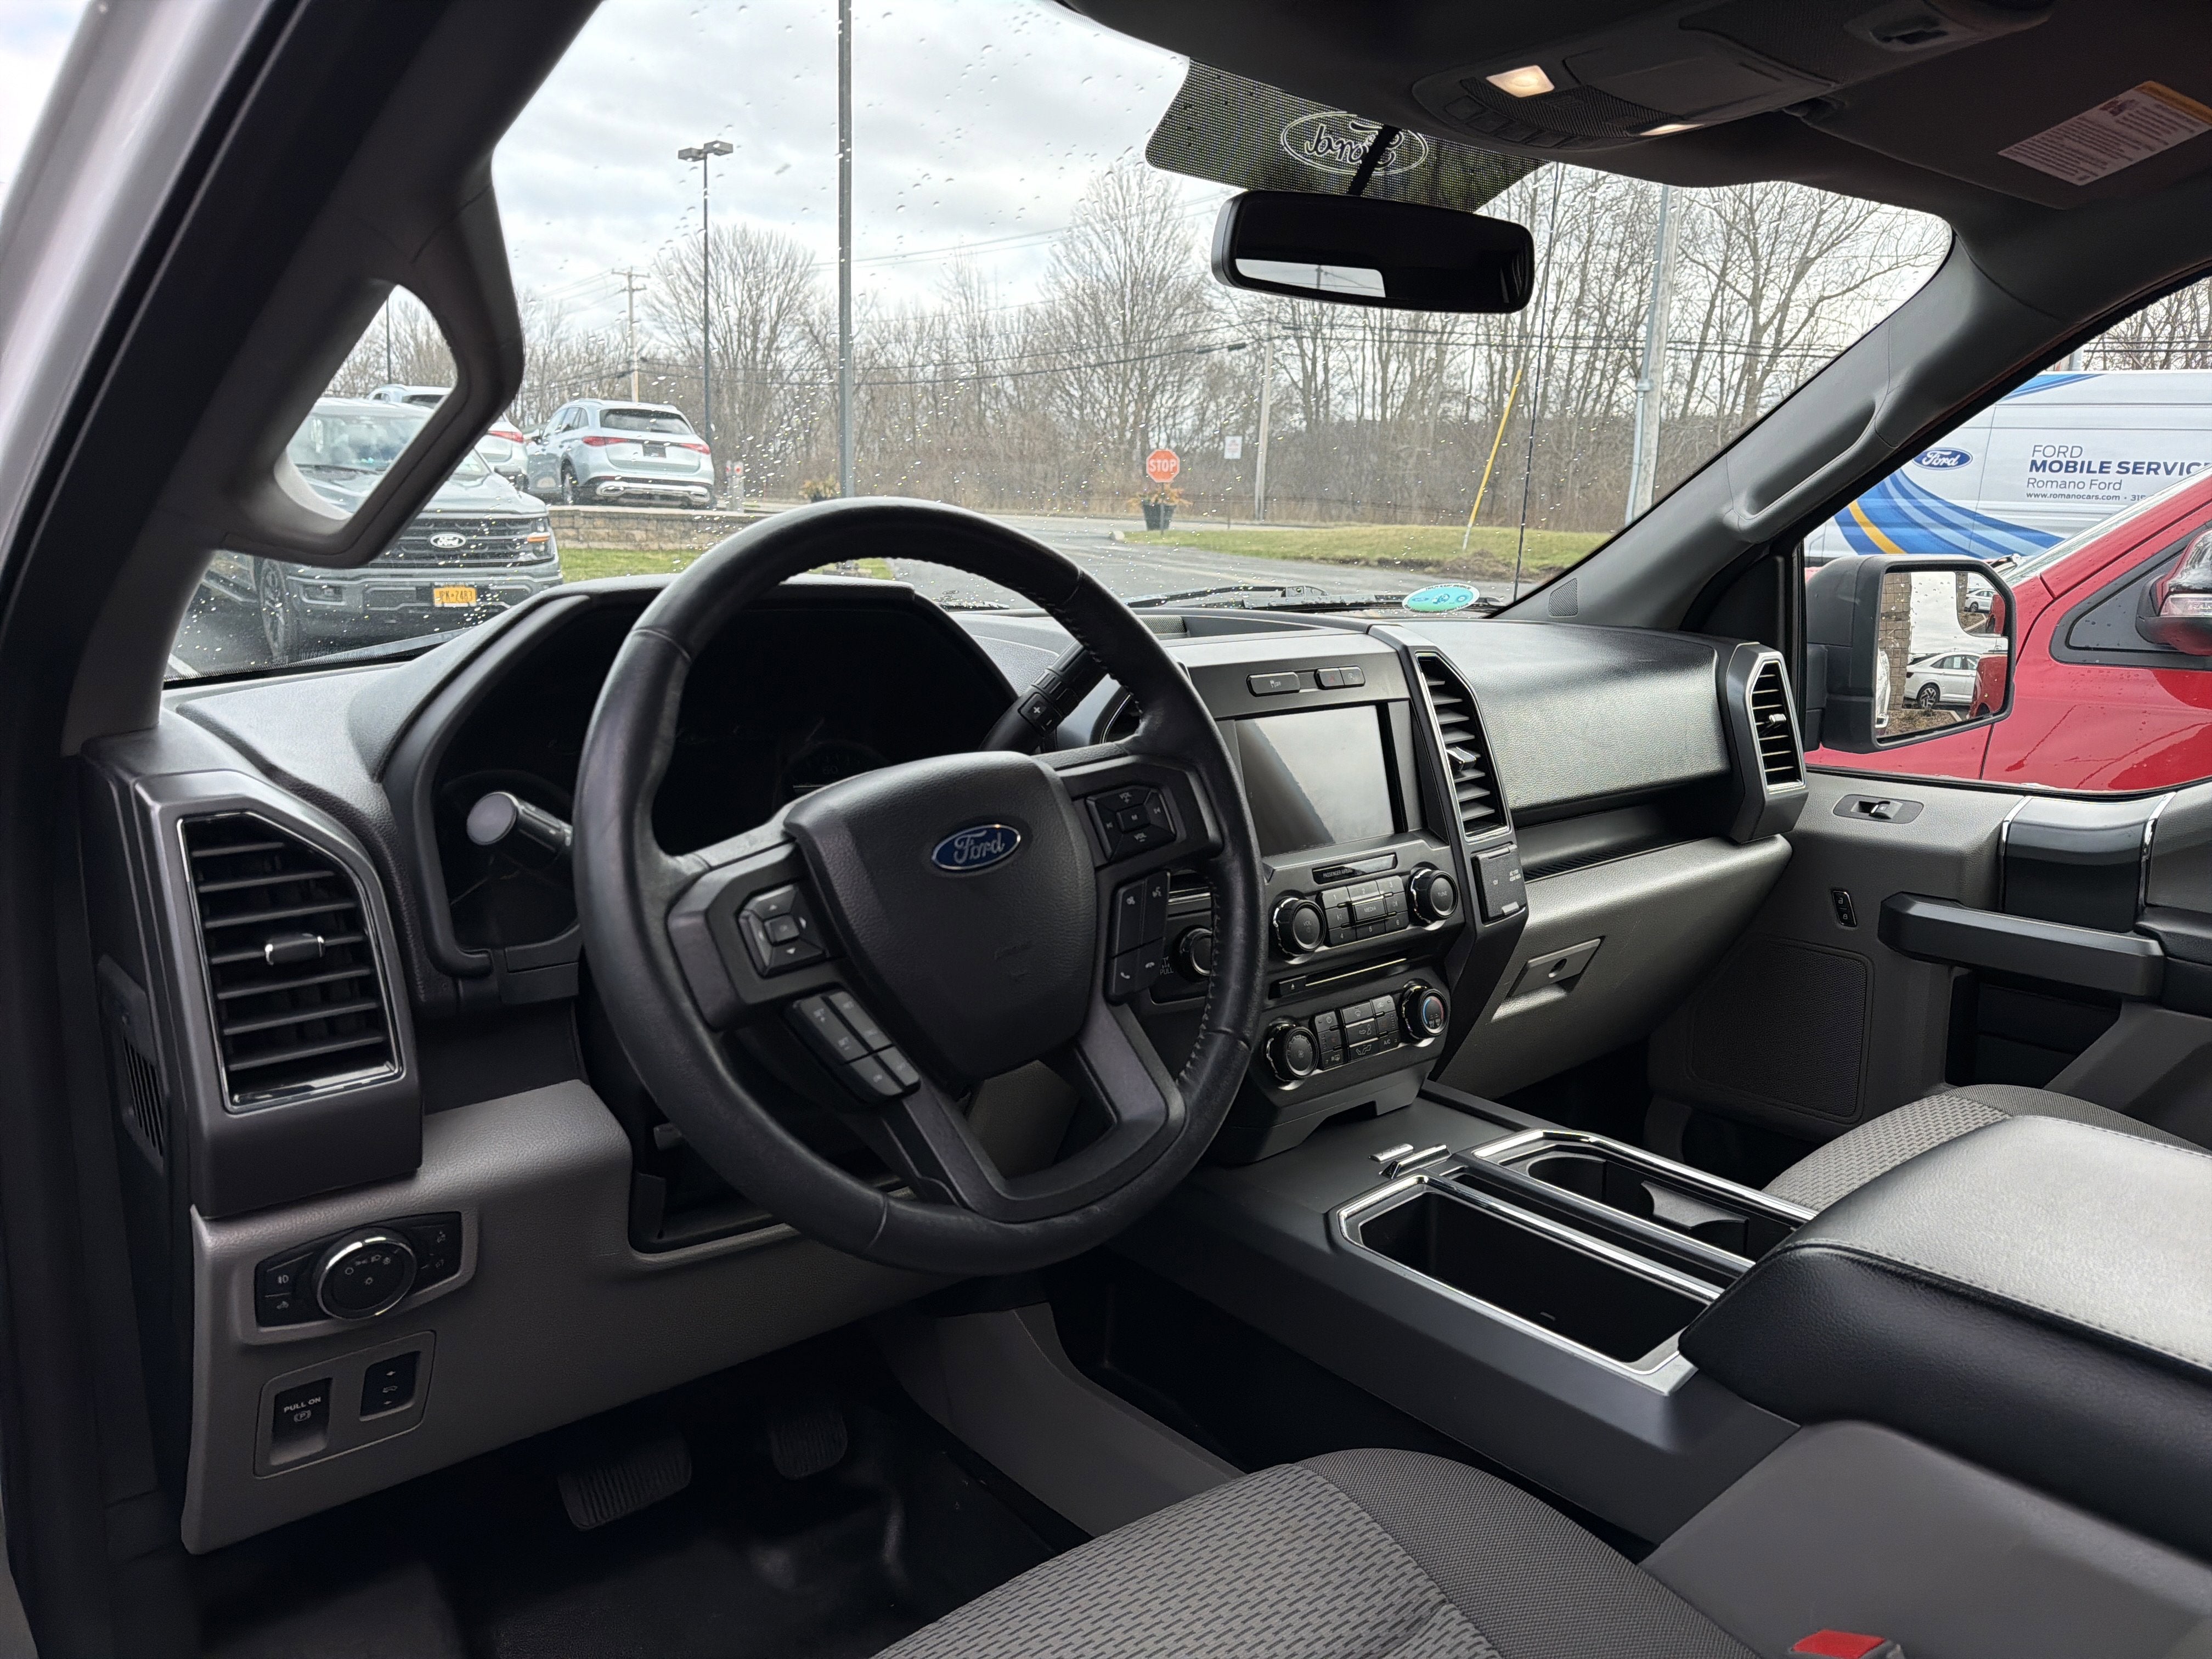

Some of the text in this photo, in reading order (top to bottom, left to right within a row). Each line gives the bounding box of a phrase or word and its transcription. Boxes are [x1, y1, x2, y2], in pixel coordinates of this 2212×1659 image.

[1922, 450, 1961, 466] Ford
[2032, 444, 2083, 458] FORD
[1148, 459, 1177, 472] STOP
[2029, 460, 2212, 476] MOBILE SERVIC
[2027, 477, 2123, 490] Romano Ford
[2026, 493, 2120, 501] www.romanocars.com
[953, 830, 1005, 864] Ford
[1160, 967, 1173, 976] PULL
[284, 1396, 321, 1414] PULL ON
